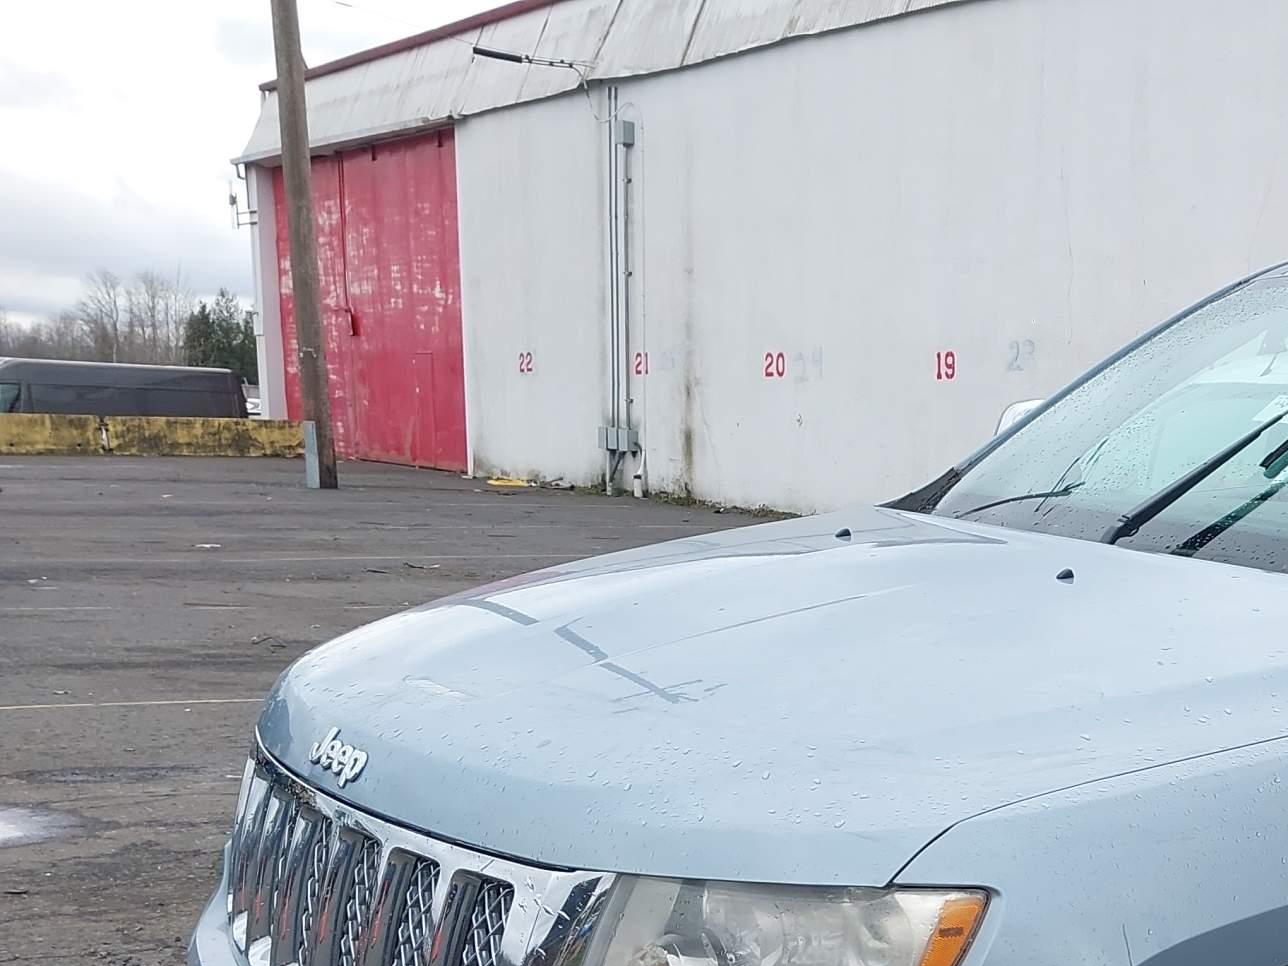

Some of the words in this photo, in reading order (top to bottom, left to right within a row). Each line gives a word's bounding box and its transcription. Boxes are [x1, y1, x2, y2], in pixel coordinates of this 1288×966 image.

[519, 352, 533, 372] 22
[635, 352, 649, 374] 21
[764, 352, 786, 378] 20
[936, 351, 956, 379] 19
[308, 726, 368, 789] Jeep
